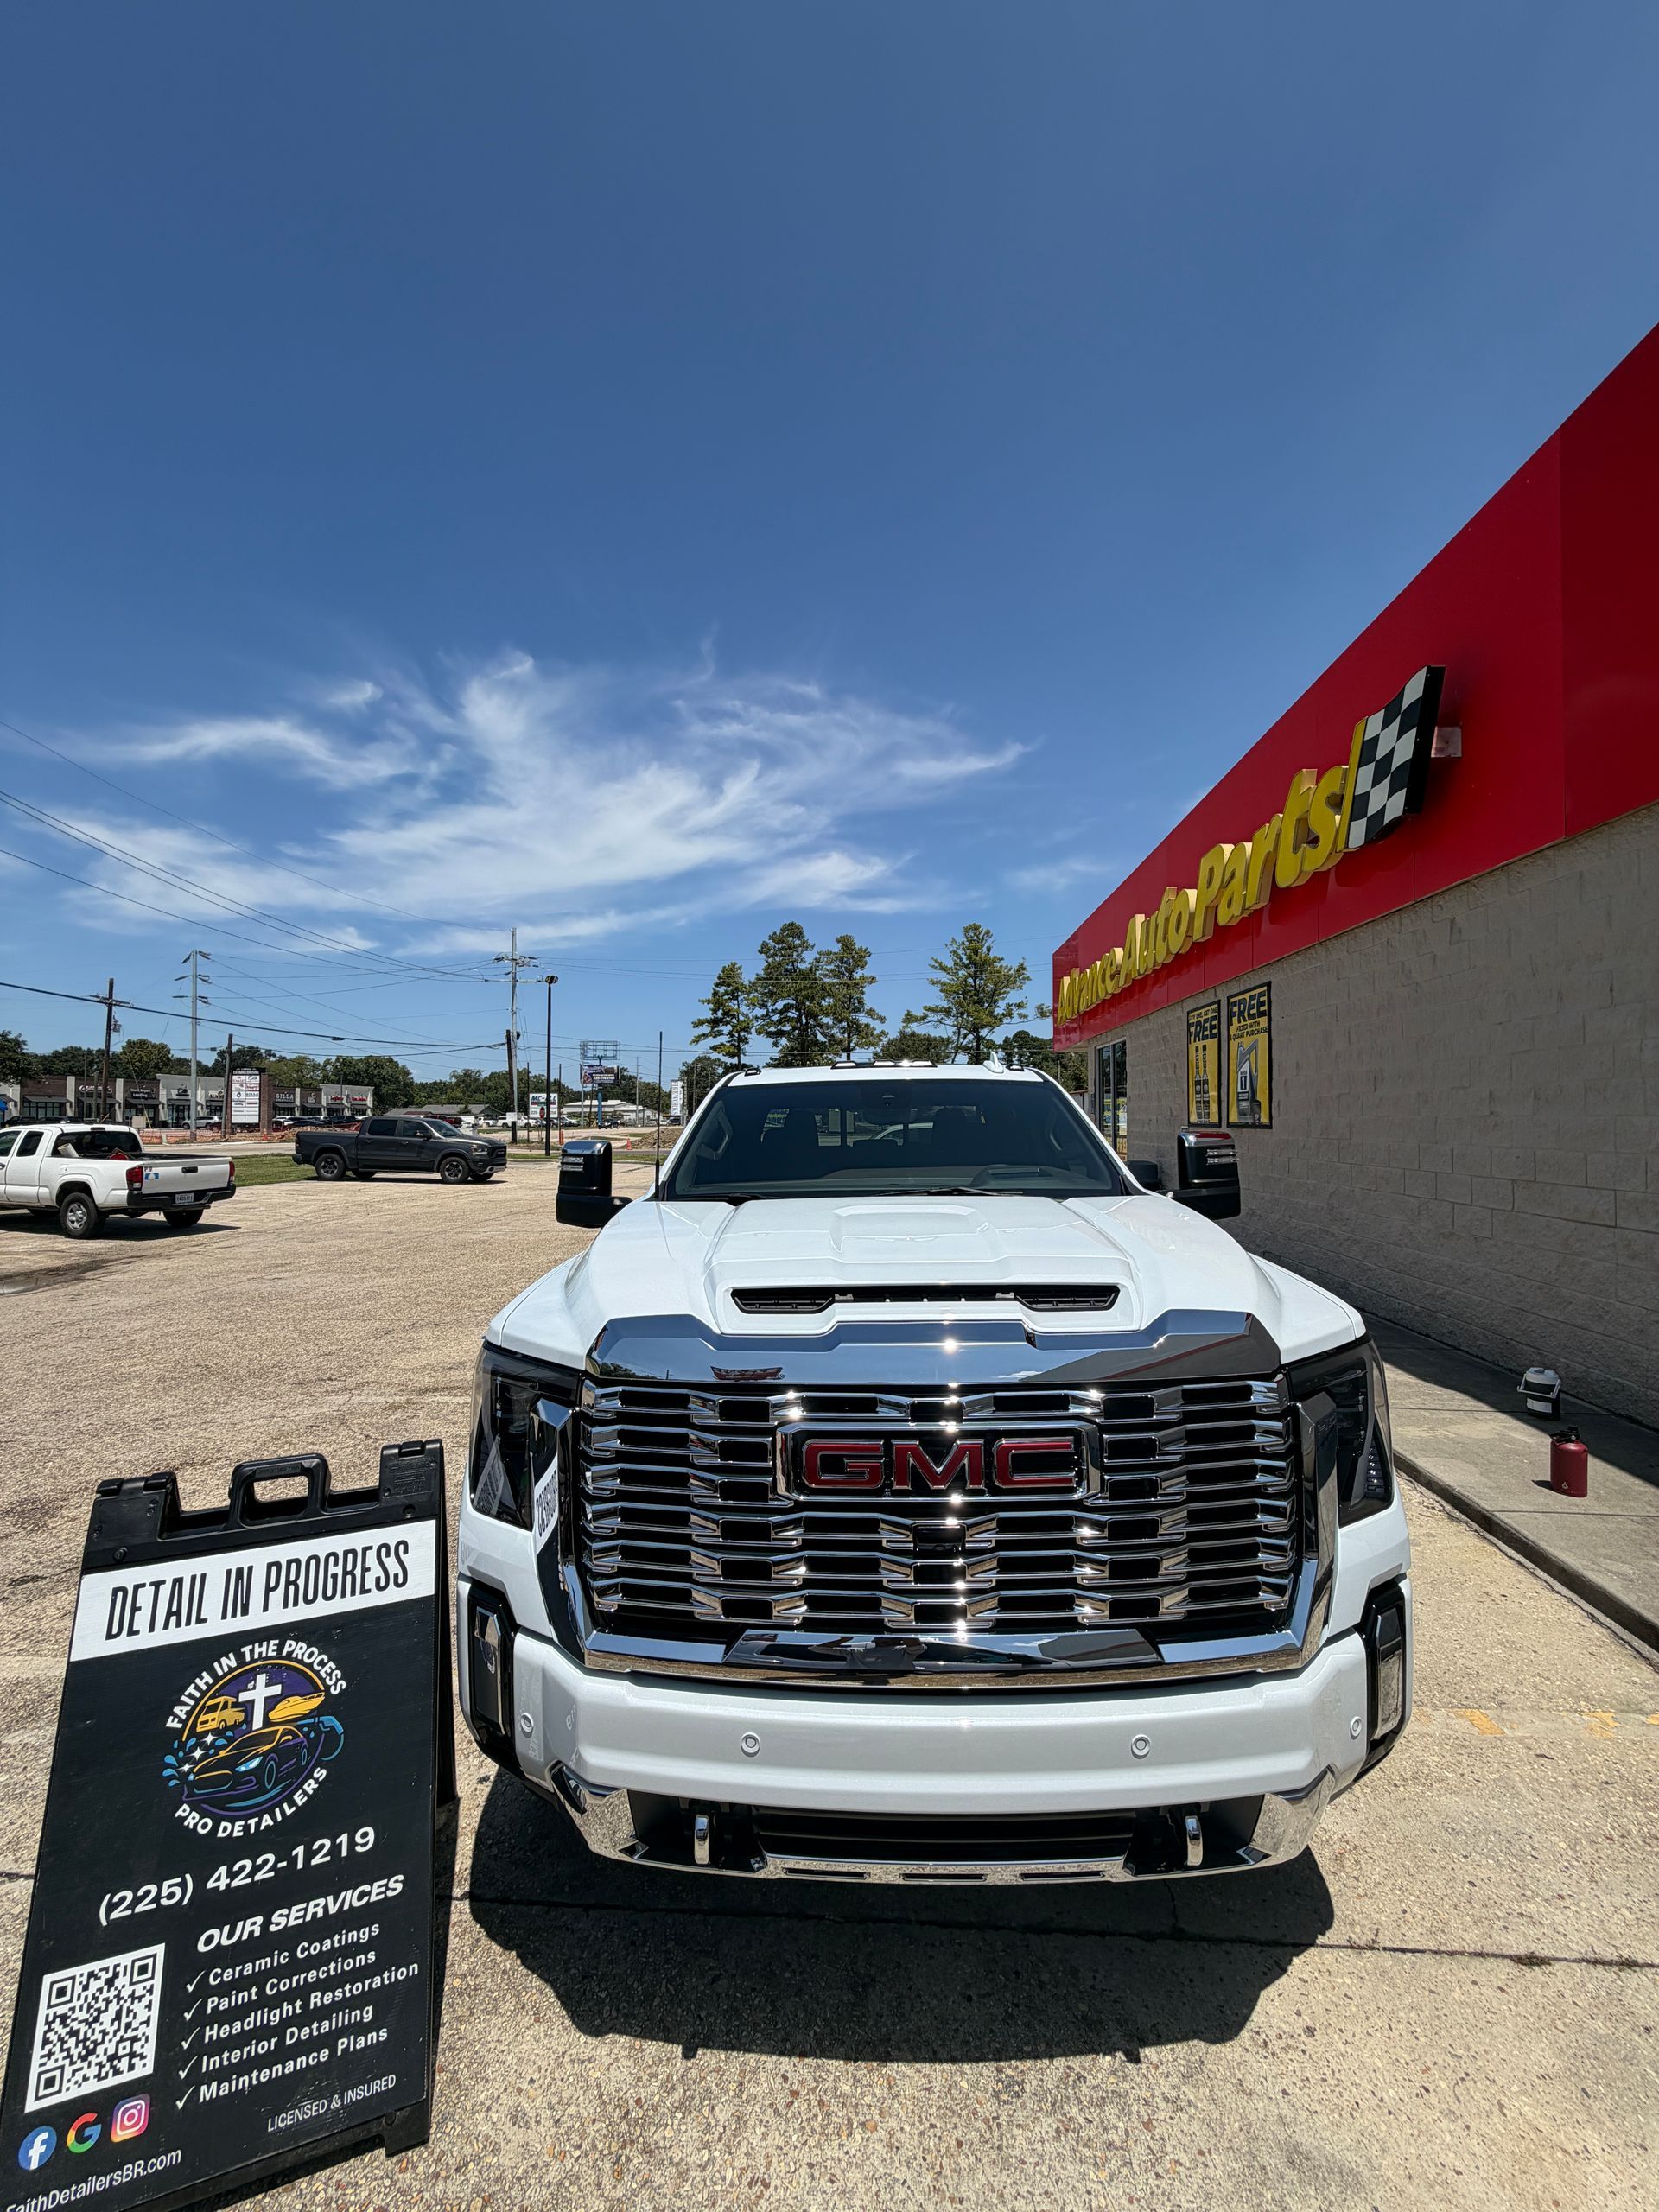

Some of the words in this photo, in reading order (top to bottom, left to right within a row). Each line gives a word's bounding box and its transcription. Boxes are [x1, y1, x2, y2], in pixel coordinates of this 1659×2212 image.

[1057, 947, 1124, 1027] Advance
[1119, 887, 1198, 988] Auto
[1193, 766, 1350, 943] Parts
[1188, 1014, 1217, 1045] FREE
[1230, 990, 1268, 1027] FREE
[1245, 1027, 1268, 1037] PURCHASE
[1249, 1020, 1261, 1029] WITH
[802, 1436, 1077, 1491] GMC
[105, 1573, 208, 1641] DETAIL
[220, 1565, 254, 1621] IN
[262, 1540, 410, 1613] PROGRESS
[166, 1671, 214, 1729] FAITH
[213, 1652, 238, 1676] IN
[241, 1639, 279, 1662] THE
[283, 1639, 346, 1695] PROCESS
[175, 1803, 213, 1834] PRO
[217, 1767, 327, 1838] DETAILERS
[99, 1873, 194, 1927] (225)
[206, 1827, 375, 1891] 422-1219
[197, 1916, 264, 1953] OUR
[269, 1874, 404, 1932] SERVICES
[207, 1986, 258, 2015] Paint
[265, 1950, 376, 1996] Corrections
[208, 1950, 289, 1986] Ceramic
[296, 1923, 380, 1959] Coatings
[204, 1999, 302, 2044] Headlight
[309, 1963, 419, 2010] Restoration
[199, 2048, 329, 2103] Maintenance
[337, 2027, 388, 2056] Plans
[201, 2036, 278, 2073] Interior
[285, 2005, 373, 2045] Detailing
[268, 2099, 327, 2133] LICENSED
[330, 2094, 341, 2109] &
[344, 2074, 397, 2105] INSURED
